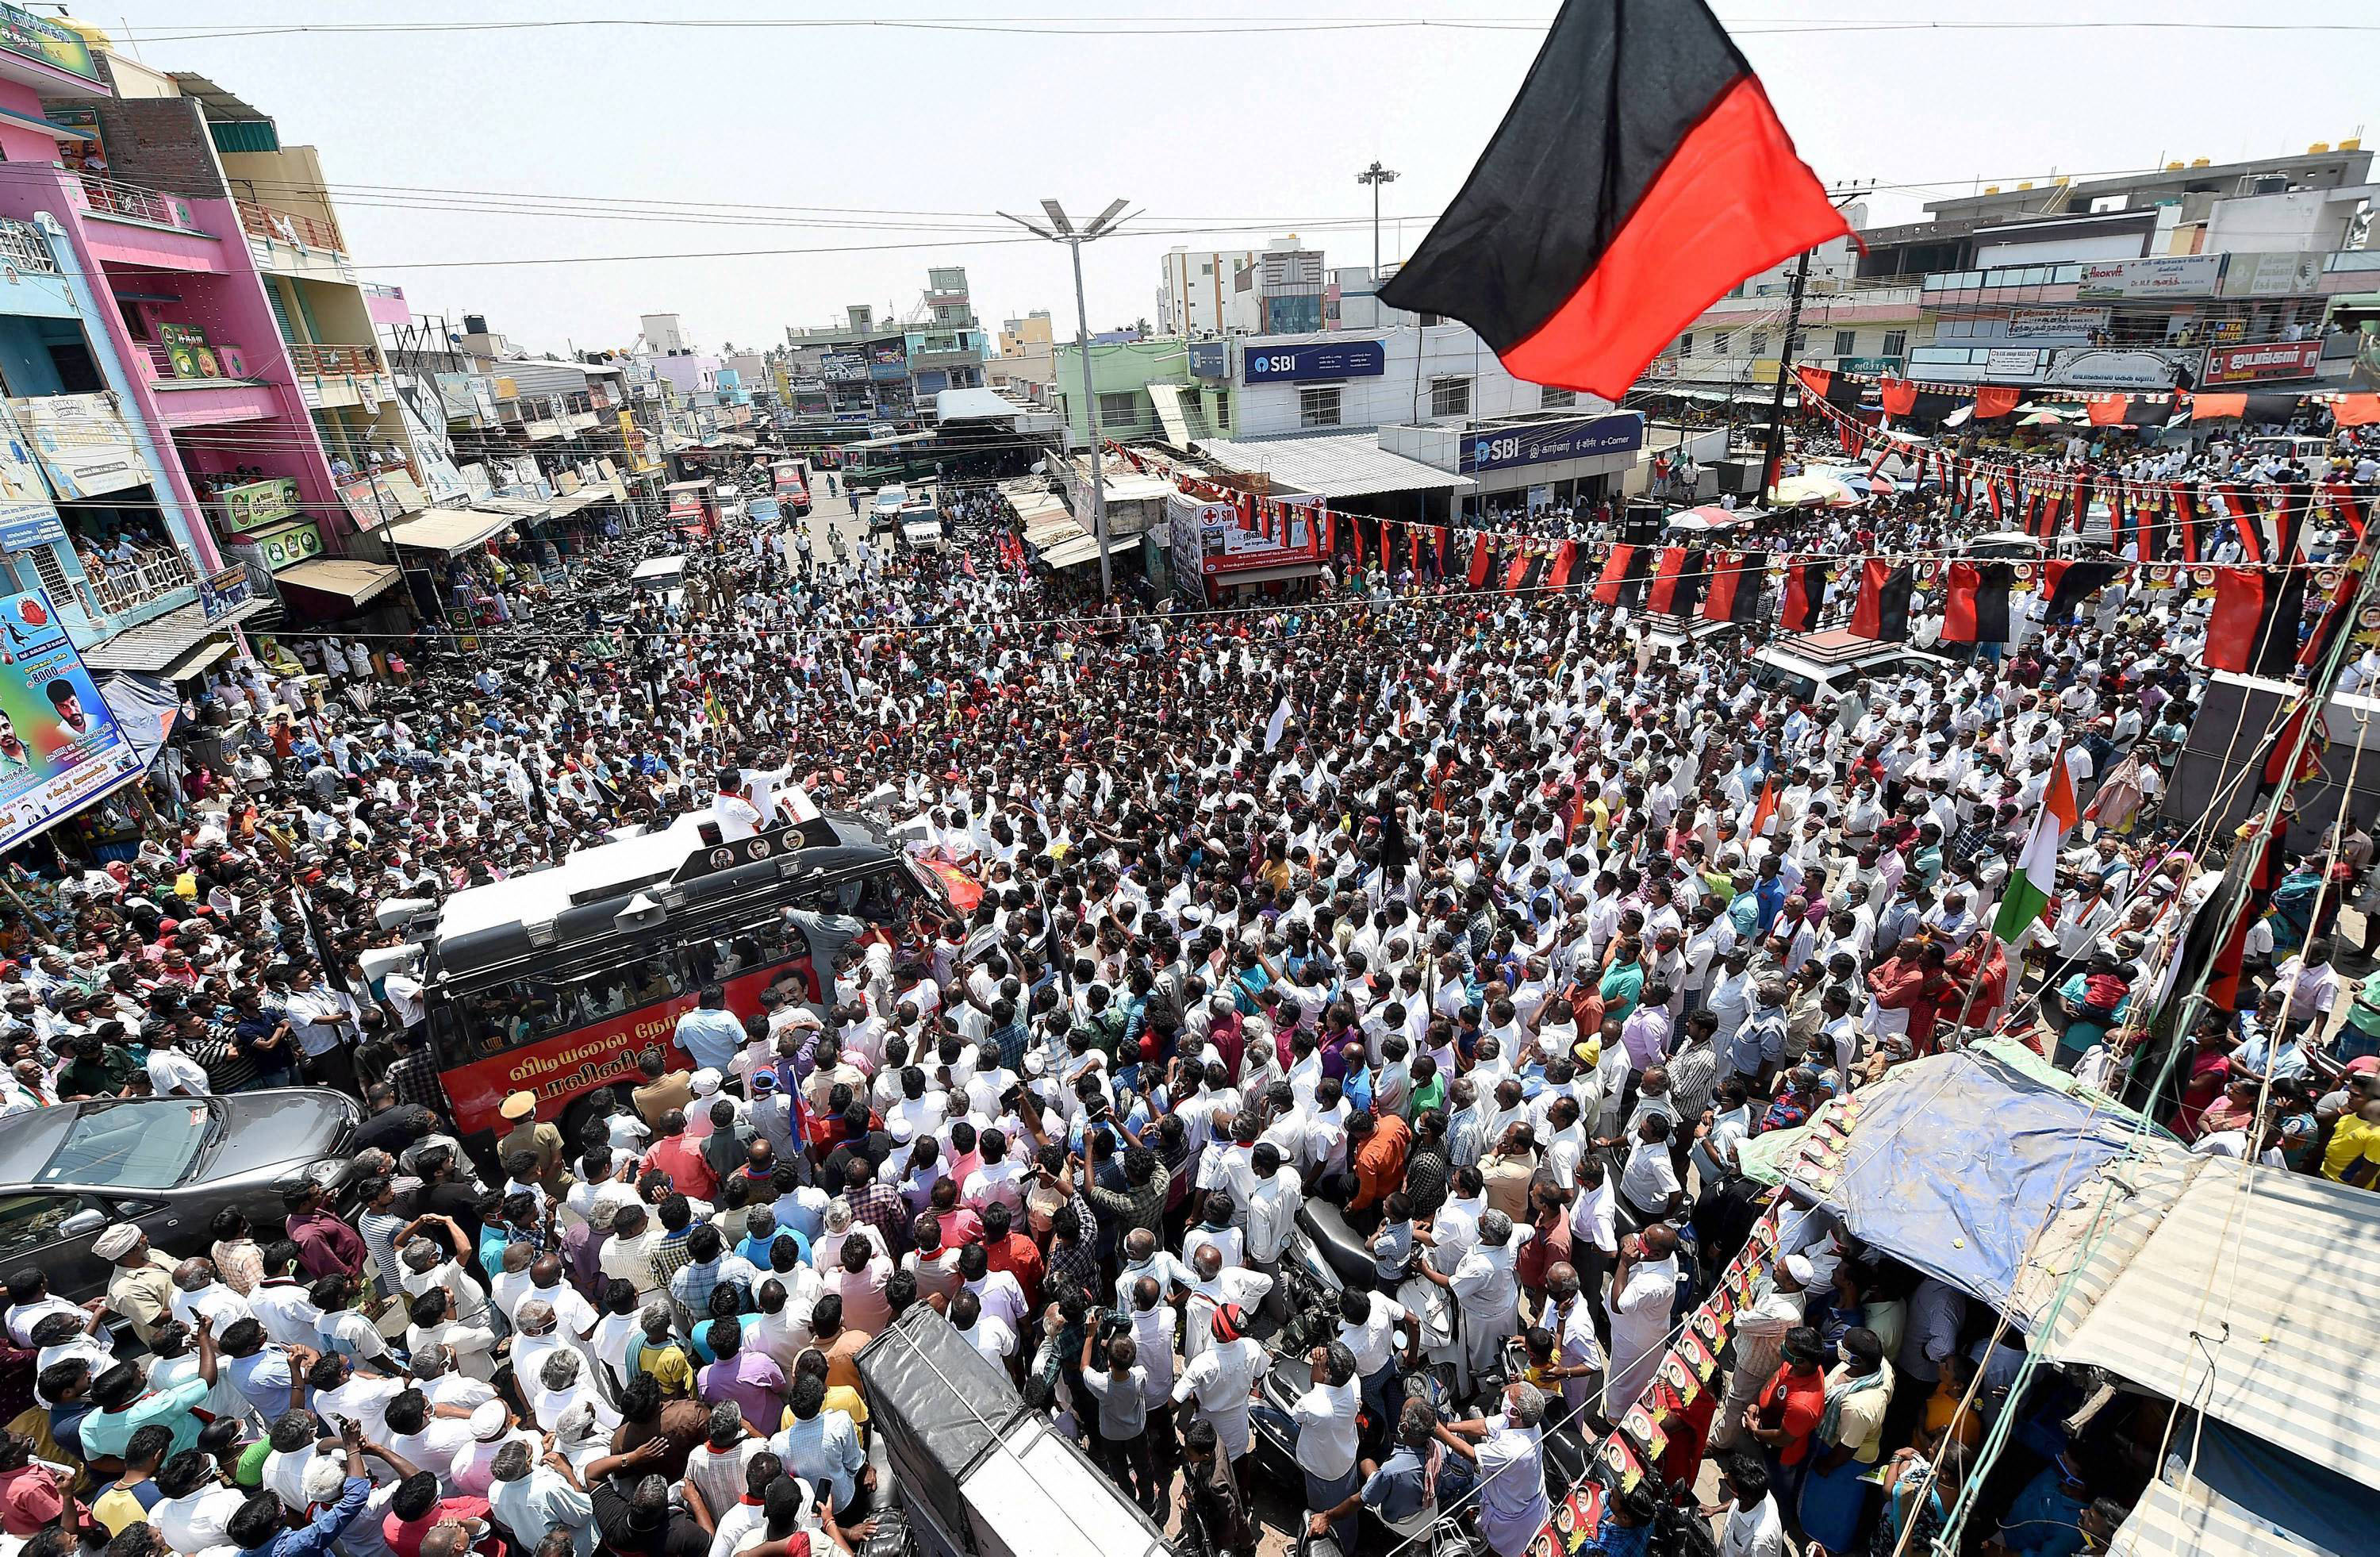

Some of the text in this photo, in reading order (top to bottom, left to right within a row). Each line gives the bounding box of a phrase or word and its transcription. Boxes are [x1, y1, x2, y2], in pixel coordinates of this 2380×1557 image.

[1270, 355, 1296, 372] SBI
[1491, 436, 1519, 461] SBI
[1529, 440, 1571, 459] இ-கார்னர்
[1601, 436, 1630, 446] e-Corner
[1221, 509, 1235, 522] SRI
[31, 665, 60, 684] 8000
[509, 1032, 628, 1082] விடியலை
